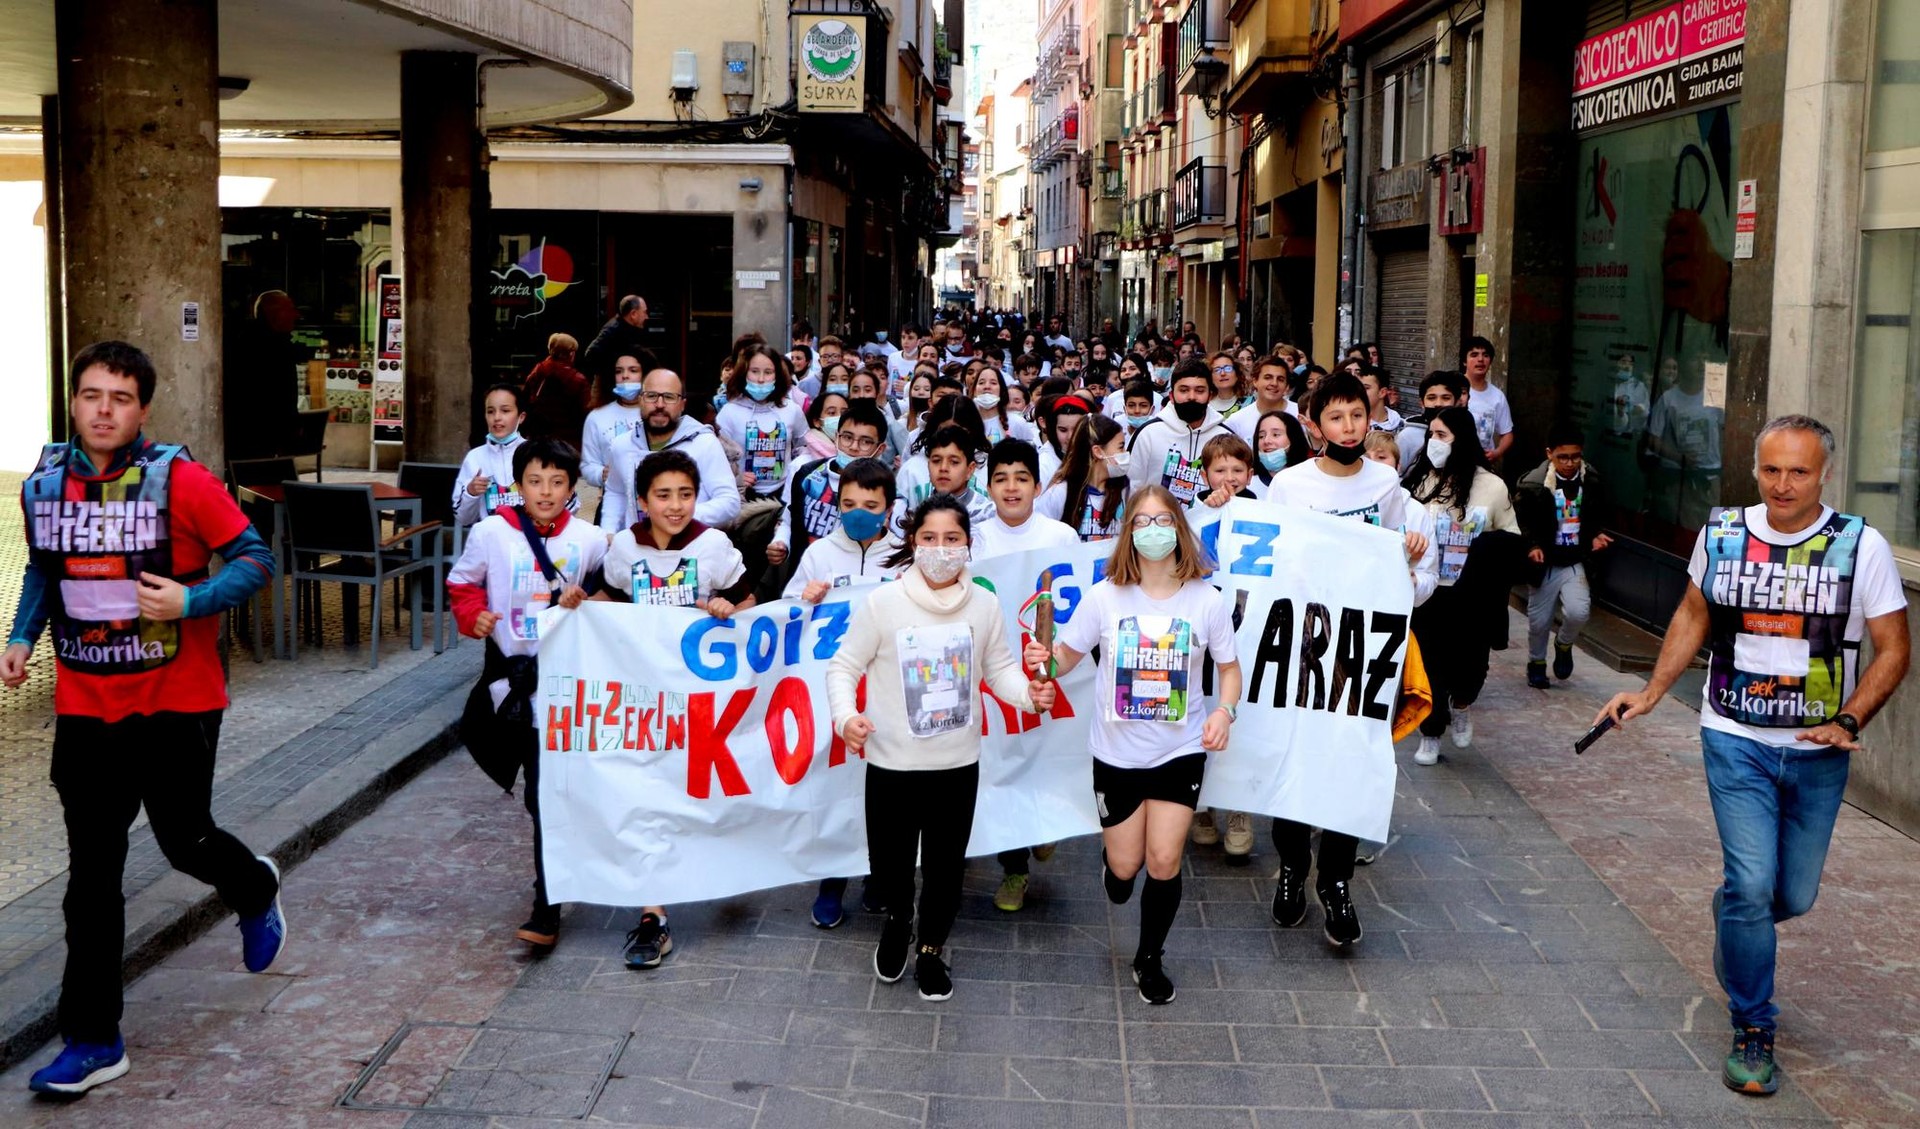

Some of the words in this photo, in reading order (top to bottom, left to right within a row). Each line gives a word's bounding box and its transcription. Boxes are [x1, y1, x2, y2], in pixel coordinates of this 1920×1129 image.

[807, 34, 857, 45] BELARDENDA
[1573, 10, 1679, 87] PSICOTECNICO
[1680, 61, 1709, 81] GIDA
[1712, 50, 1742, 72] BAIM
[804, 86, 857, 101] SURYA
[1571, 72, 1676, 130] PSIKOTEKNIKOA
[35, 500, 157, 552] HITZEKIN
[1712, 560, 1840, 615] HITZEKIN
[82, 626, 109, 644] aek
[1746, 618, 1787, 631] euskaltel
[1123, 647, 1183, 670] HITZEKIN
[1748, 678, 1776, 697] aek
[546, 676, 686, 752] HITZEKIN
